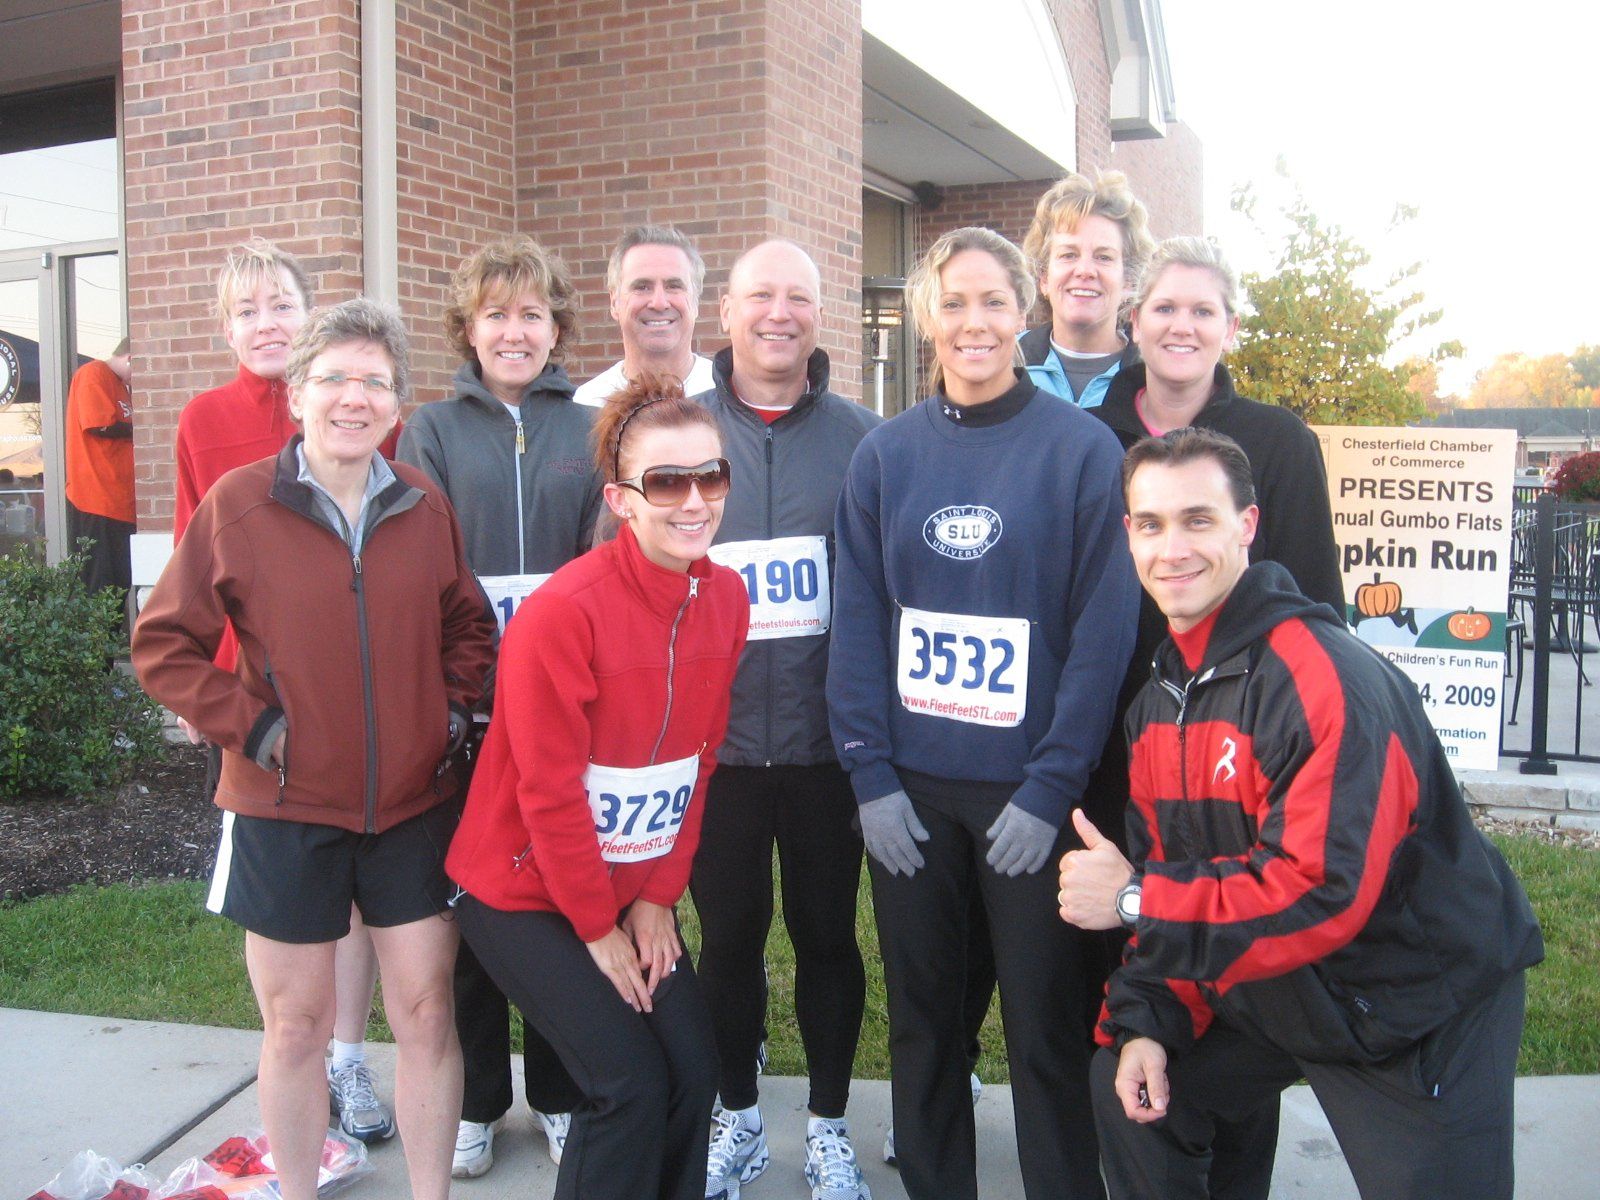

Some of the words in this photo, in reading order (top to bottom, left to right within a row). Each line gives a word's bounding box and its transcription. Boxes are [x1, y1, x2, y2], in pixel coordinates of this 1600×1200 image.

[1342, 437, 1425, 451] Chesterfield
[1430, 440, 1493, 452] Chamber
[1372, 456, 1386, 466] of
[1390, 456, 1465, 469] Commerce
[1340, 477, 1493, 503] PRESENTS
[933, 509, 966, 524] SAINT
[971, 508, 996, 524] LOUIS
[1334, 509, 1374, 526] nual
[1380, 510, 1450, 529] Gumbo
[1456, 512, 1503, 531] Flats
[948, 525, 981, 539] SLU
[1335, 537, 1417, 573] pkin
[1431, 540, 1497, 571] Run
[730, 558, 819, 605] 190
[749, 617, 820, 630] etfeetstlouis.com
[908, 627, 1015, 694] 3532
[1387, 652, 1446, 666] Children's
[1449, 656, 1471, 668] Fun
[1475, 657, 1498, 669] Run
[1417, 683, 1437, 707] 4,
[1445, 684, 1496, 707] 2009
[903, 695, 1018, 722] www.FleetFeetSTL.com
[588, 785, 691, 836] 3729
